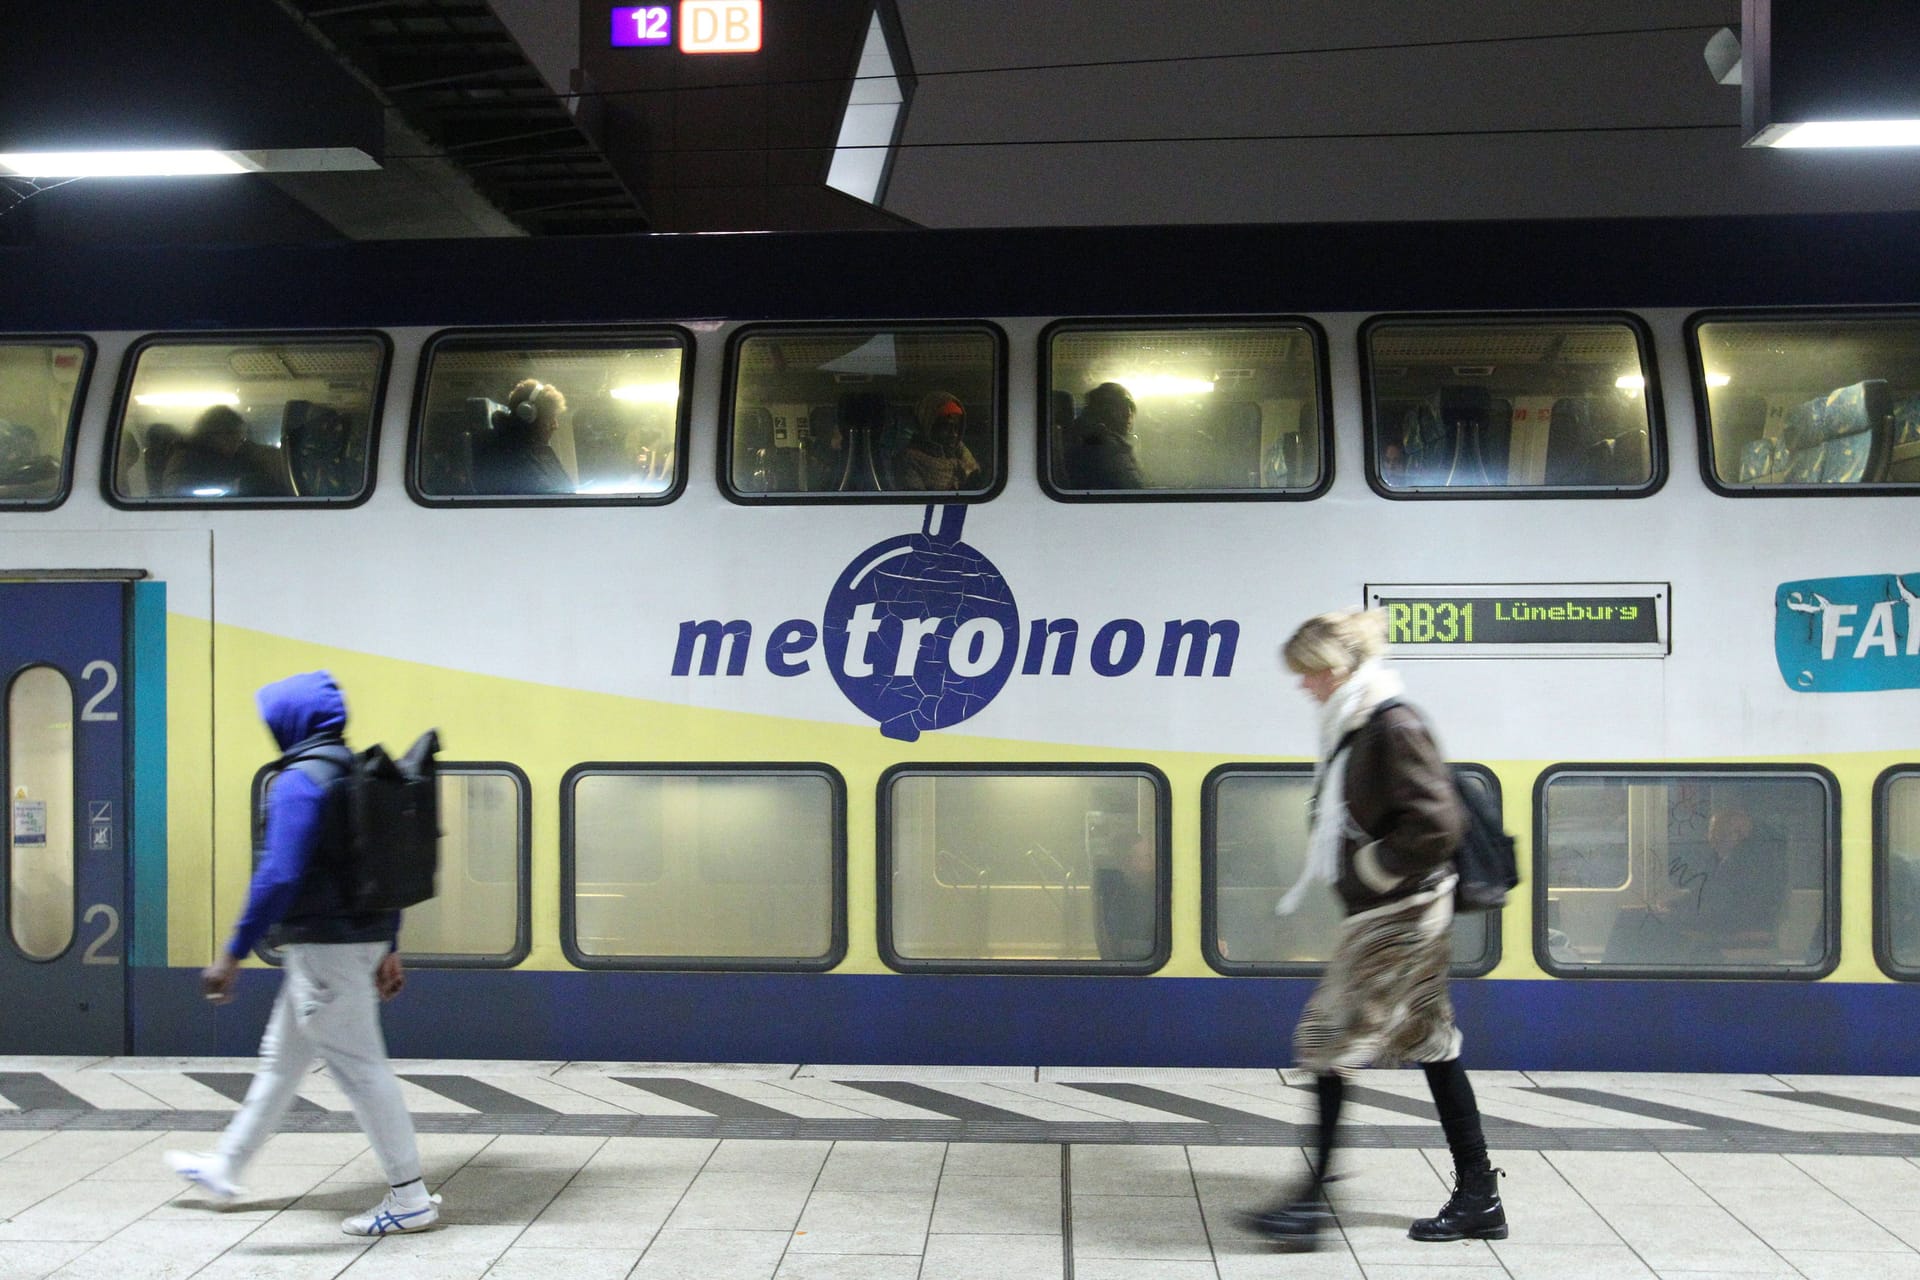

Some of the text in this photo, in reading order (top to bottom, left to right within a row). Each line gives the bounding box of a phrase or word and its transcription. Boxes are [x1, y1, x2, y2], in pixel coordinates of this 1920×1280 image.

[631, 7, 668, 39] 12
[692, 6, 750, 43] DB
[671, 602, 1240, 678] metronom
[1388, 601, 1638, 642] RB31 Lüneburg
[80, 660, 118, 721] 2
[82, 904, 120, 965] 2
